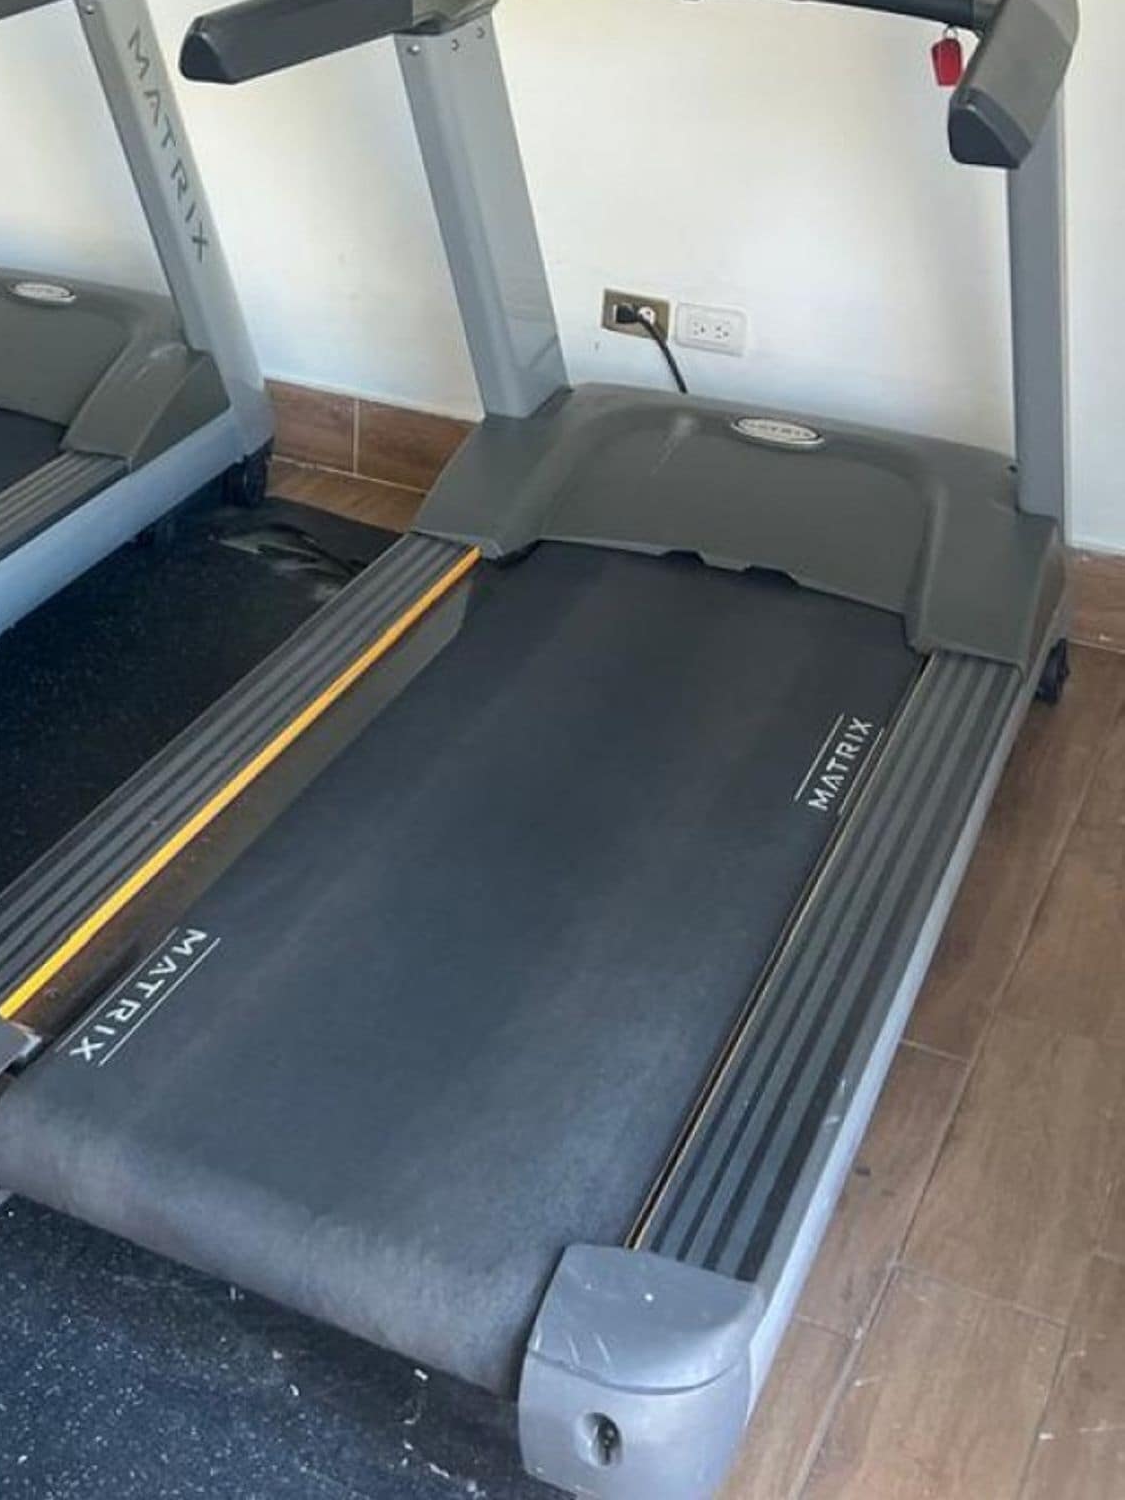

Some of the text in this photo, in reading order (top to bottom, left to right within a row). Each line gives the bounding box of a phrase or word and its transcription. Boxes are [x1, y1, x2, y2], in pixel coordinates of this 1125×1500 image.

[127, 28, 209, 263] MATRIX
[808, 716, 874, 811] MATRIX
[69, 928, 208, 1061] MATRIX
